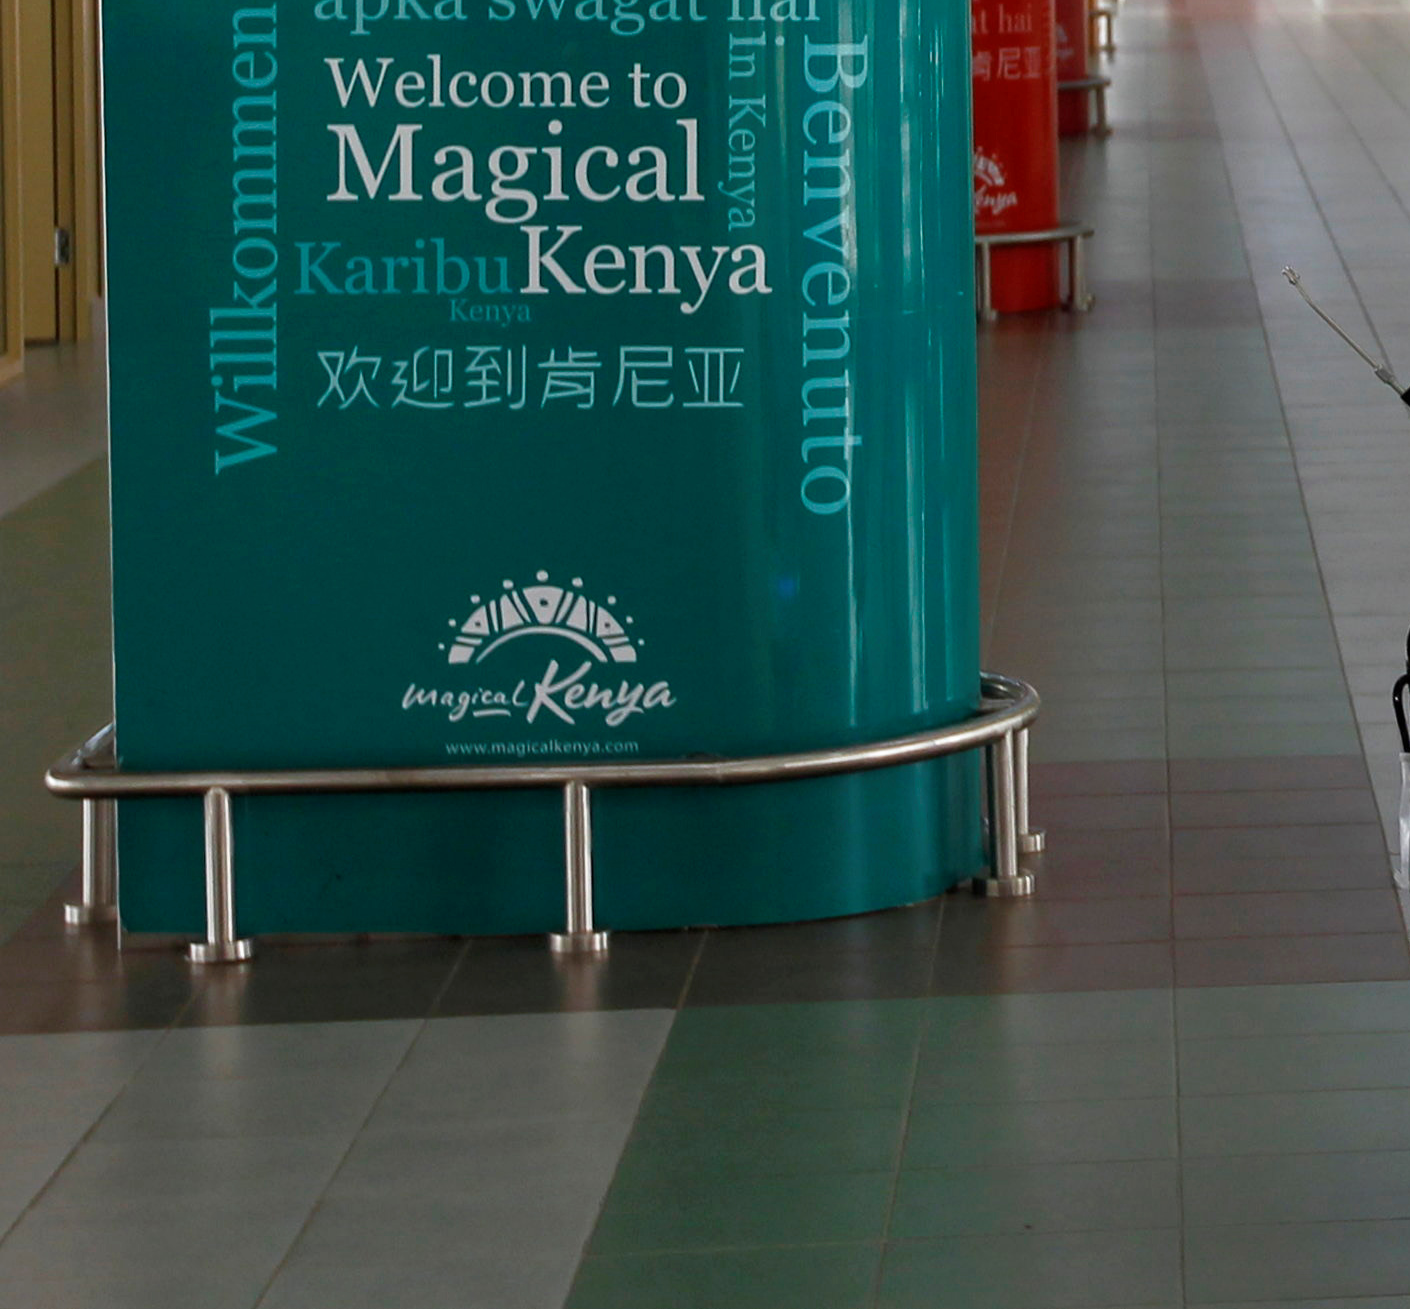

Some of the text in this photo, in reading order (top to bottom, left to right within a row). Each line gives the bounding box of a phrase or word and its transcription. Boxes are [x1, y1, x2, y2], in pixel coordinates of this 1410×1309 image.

[325, 54, 688, 108] Welcome to
[327, 119, 705, 224] Magical
[717, 94, 766, 232] Kenya
[208, 2, 278, 476] Willkommen
[295, 225, 773, 314] Karibu Kenya
[801, 34, 869, 516] Benvenuto
[449, 299, 531, 327] Kenya
[316, 345, 745, 410] 欢迎到肯尼亚
[527, 659, 677, 727] Kenya
[445, 740, 639, 757] www.magicalkenya.com
